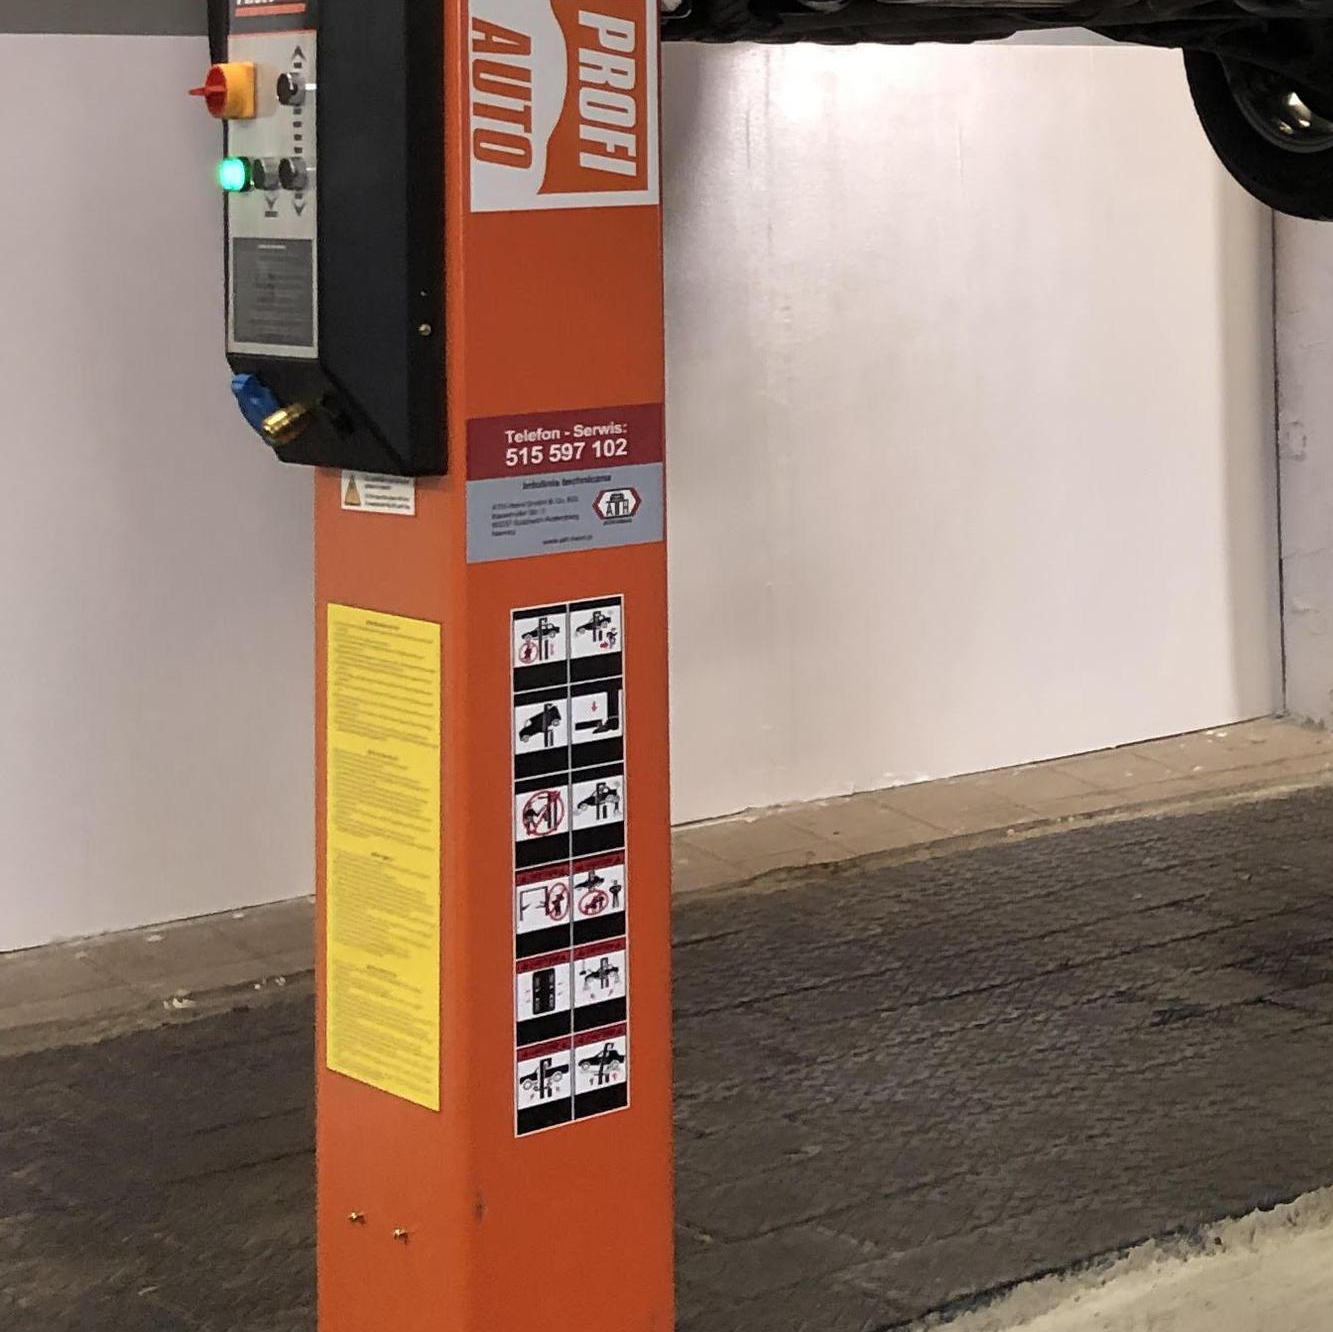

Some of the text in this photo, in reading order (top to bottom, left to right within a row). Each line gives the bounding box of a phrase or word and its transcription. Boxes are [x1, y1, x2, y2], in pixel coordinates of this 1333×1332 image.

[472, 15, 533, 170] AUTO
[577, 8, 638, 177] PROFI
[505, 428, 561, 444] Telefon
[573, 422, 628, 438] Serwis:
[505, 438, 628, 467] 515 597 102
